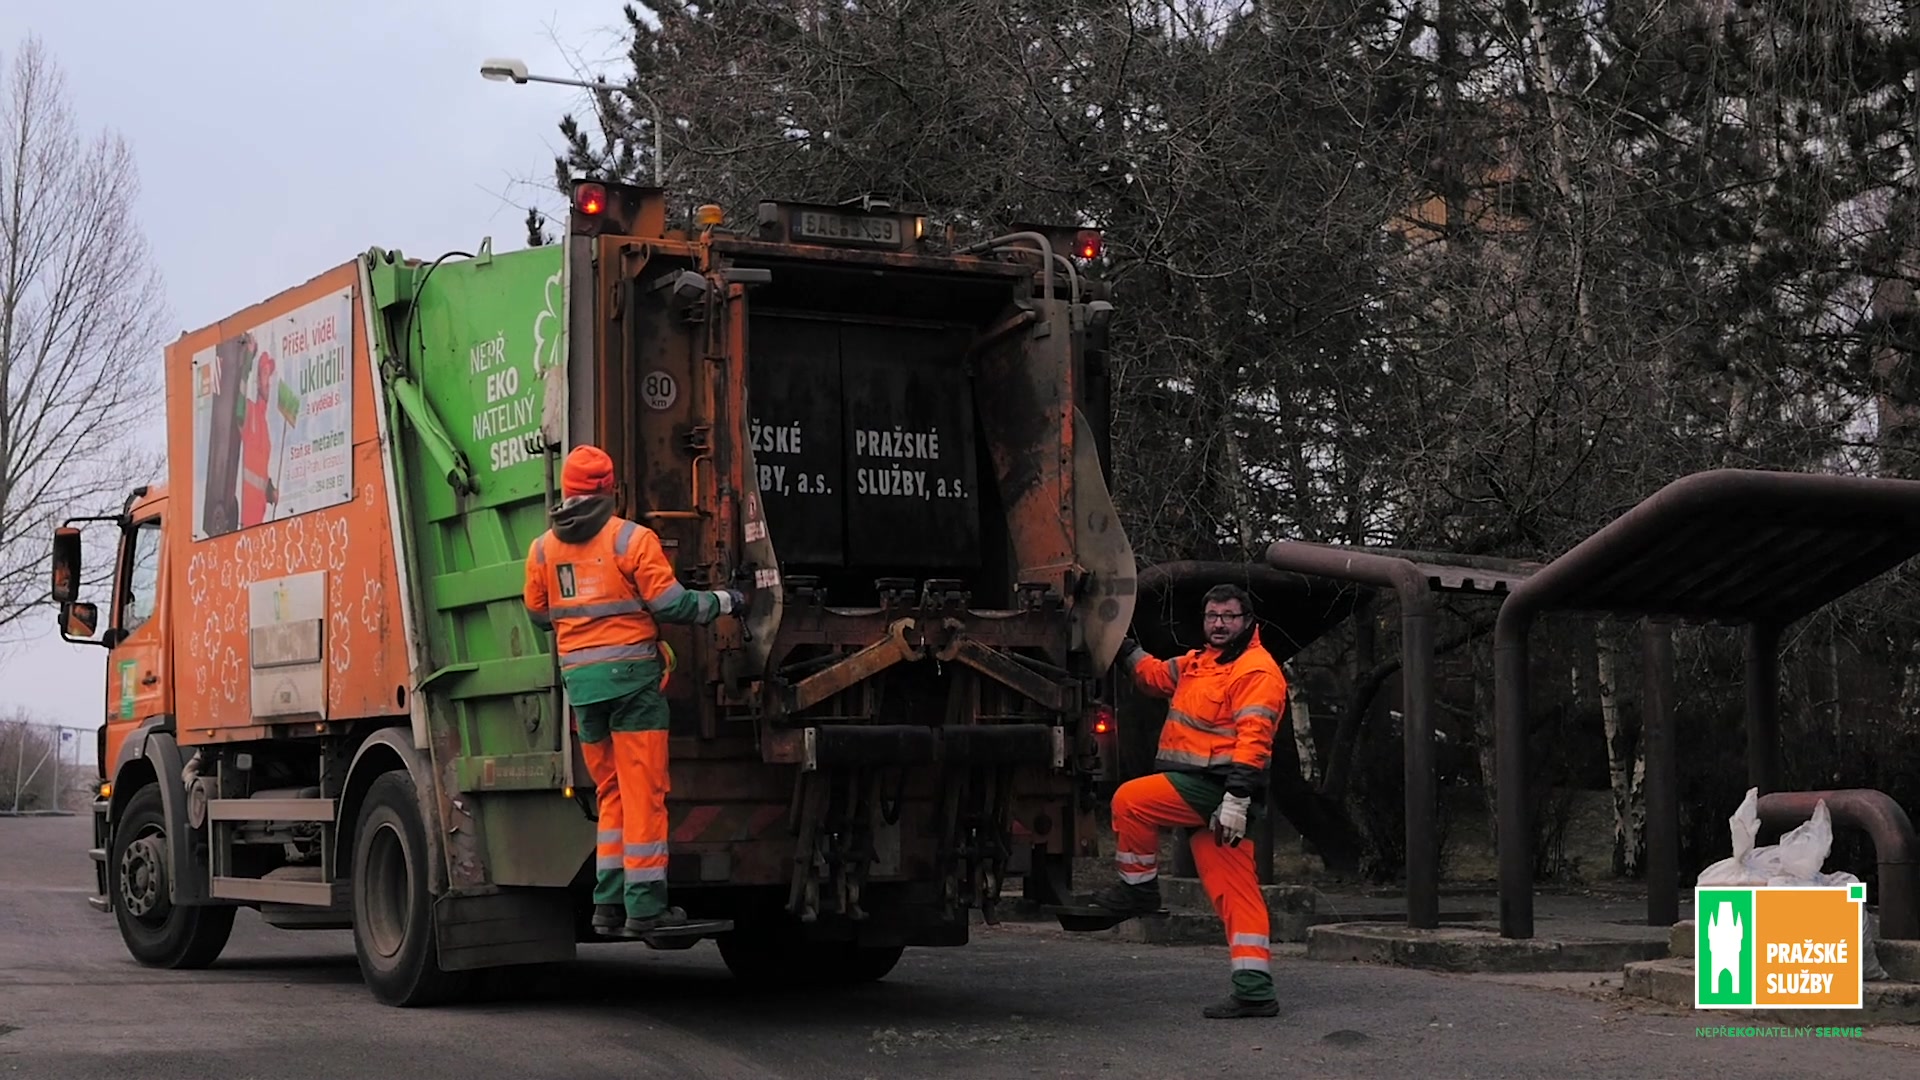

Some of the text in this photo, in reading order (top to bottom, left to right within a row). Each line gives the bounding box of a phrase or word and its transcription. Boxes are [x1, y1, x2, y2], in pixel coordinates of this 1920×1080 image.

[300, 345, 344, 395] uklidil!
[470, 329, 506, 375] NEPŘ
[487, 366, 518, 403] EKO
[647, 376, 671, 397] 80
[652, 397, 667, 407] km
[472, 388, 536, 442] NATELNÝ
[751, 418, 801, 454] ŽSKÉ
[855, 425, 939, 459] PRAŽSKÉ
[797, 473, 832, 494] a.s.
[857, 463, 969, 500] SLUŽBY, a.s.
